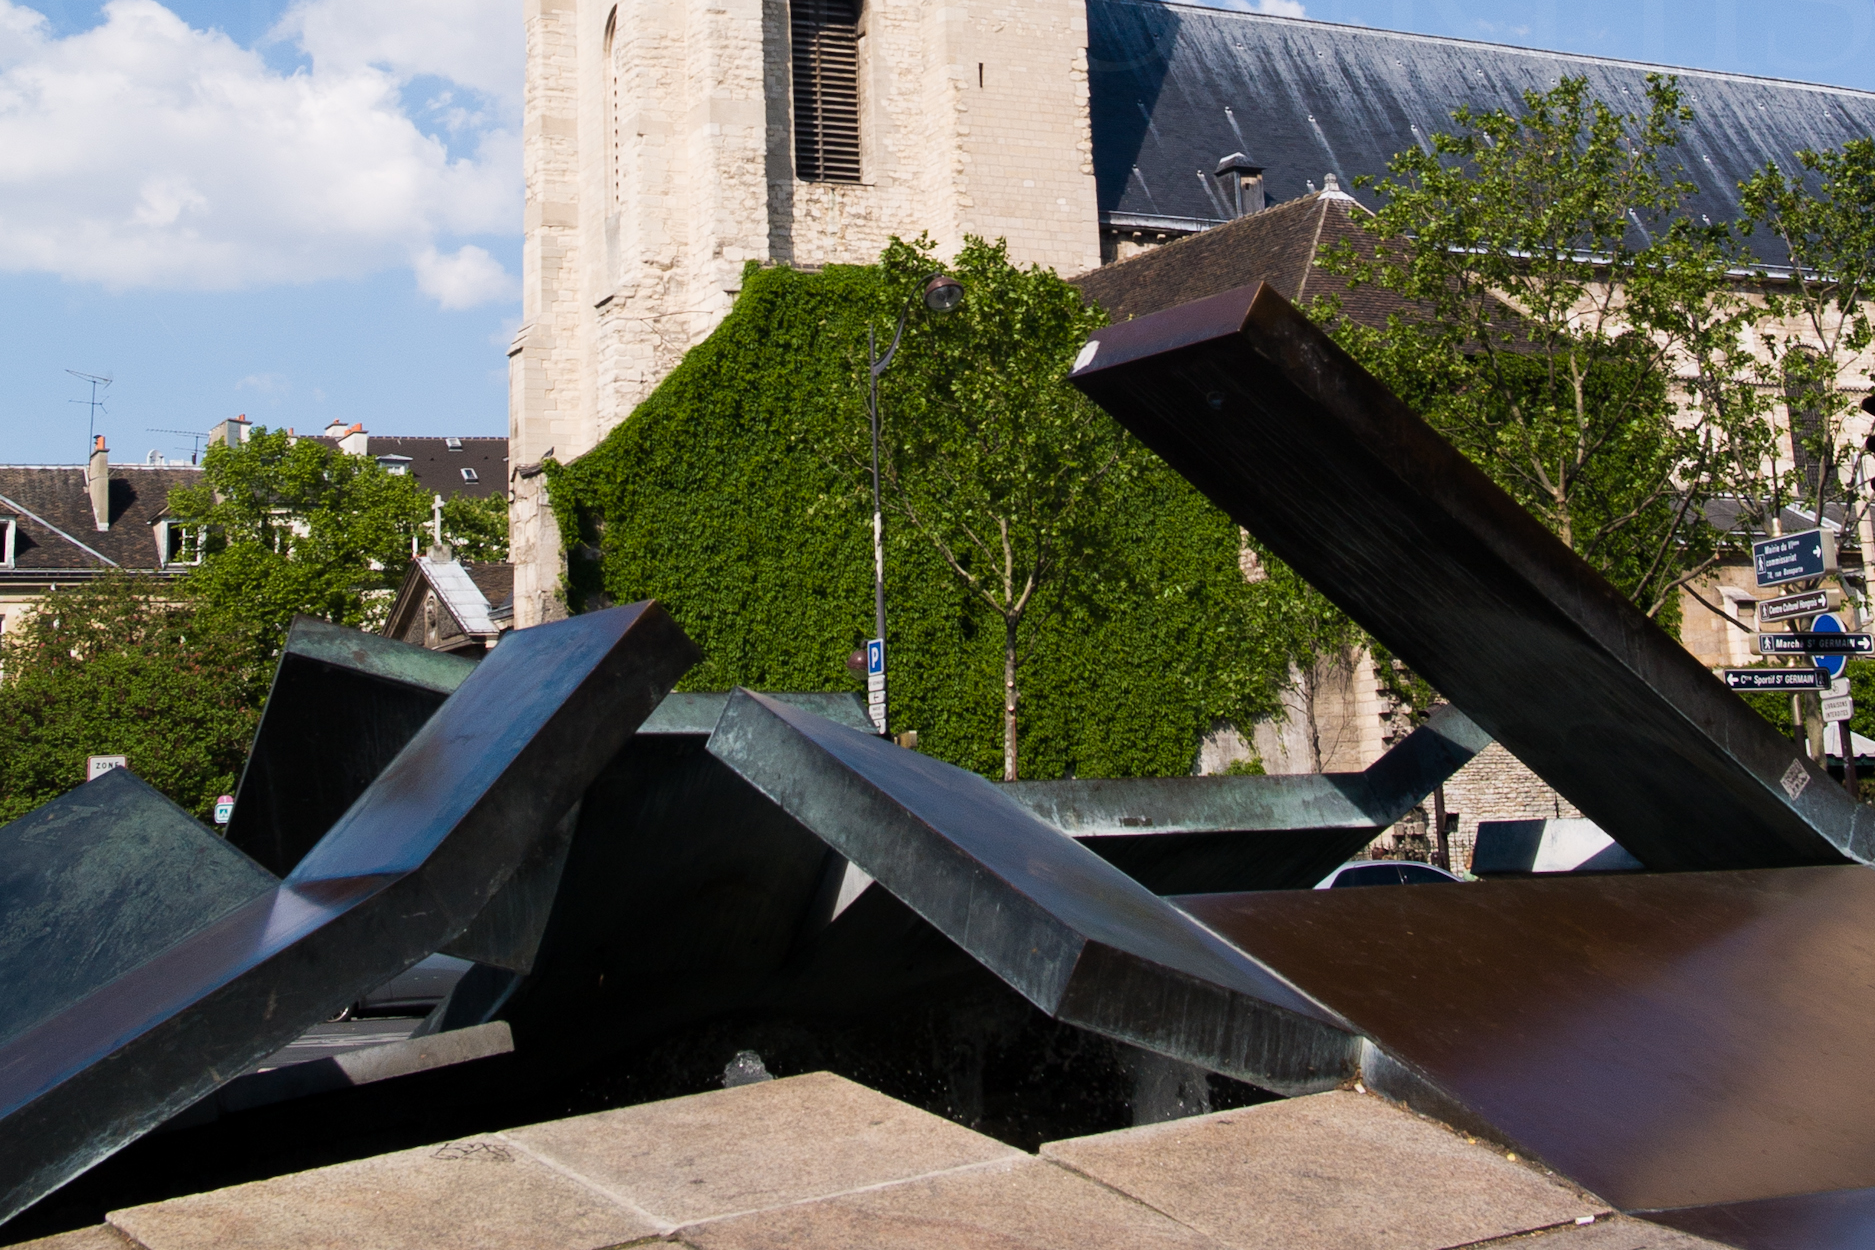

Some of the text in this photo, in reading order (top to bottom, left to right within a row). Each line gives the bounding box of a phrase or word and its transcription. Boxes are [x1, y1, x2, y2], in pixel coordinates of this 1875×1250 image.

[1765, 553, 1797, 567] commissariat
[1769, 605, 1783, 615] Centre
[1782, 600, 1799, 613] Culturel
[1819, 638, 1855, 648] GERMAIN
[871, 646, 879, 668] P
[1753, 674, 1775, 686] Sportif
[1784, 674, 1814, 684] GERMAIN
[1824, 700, 1848, 710] LIVRAISONS
[1825, 709, 1849, 718] INTERDITES
[96, 761, 119, 769] ZONE
